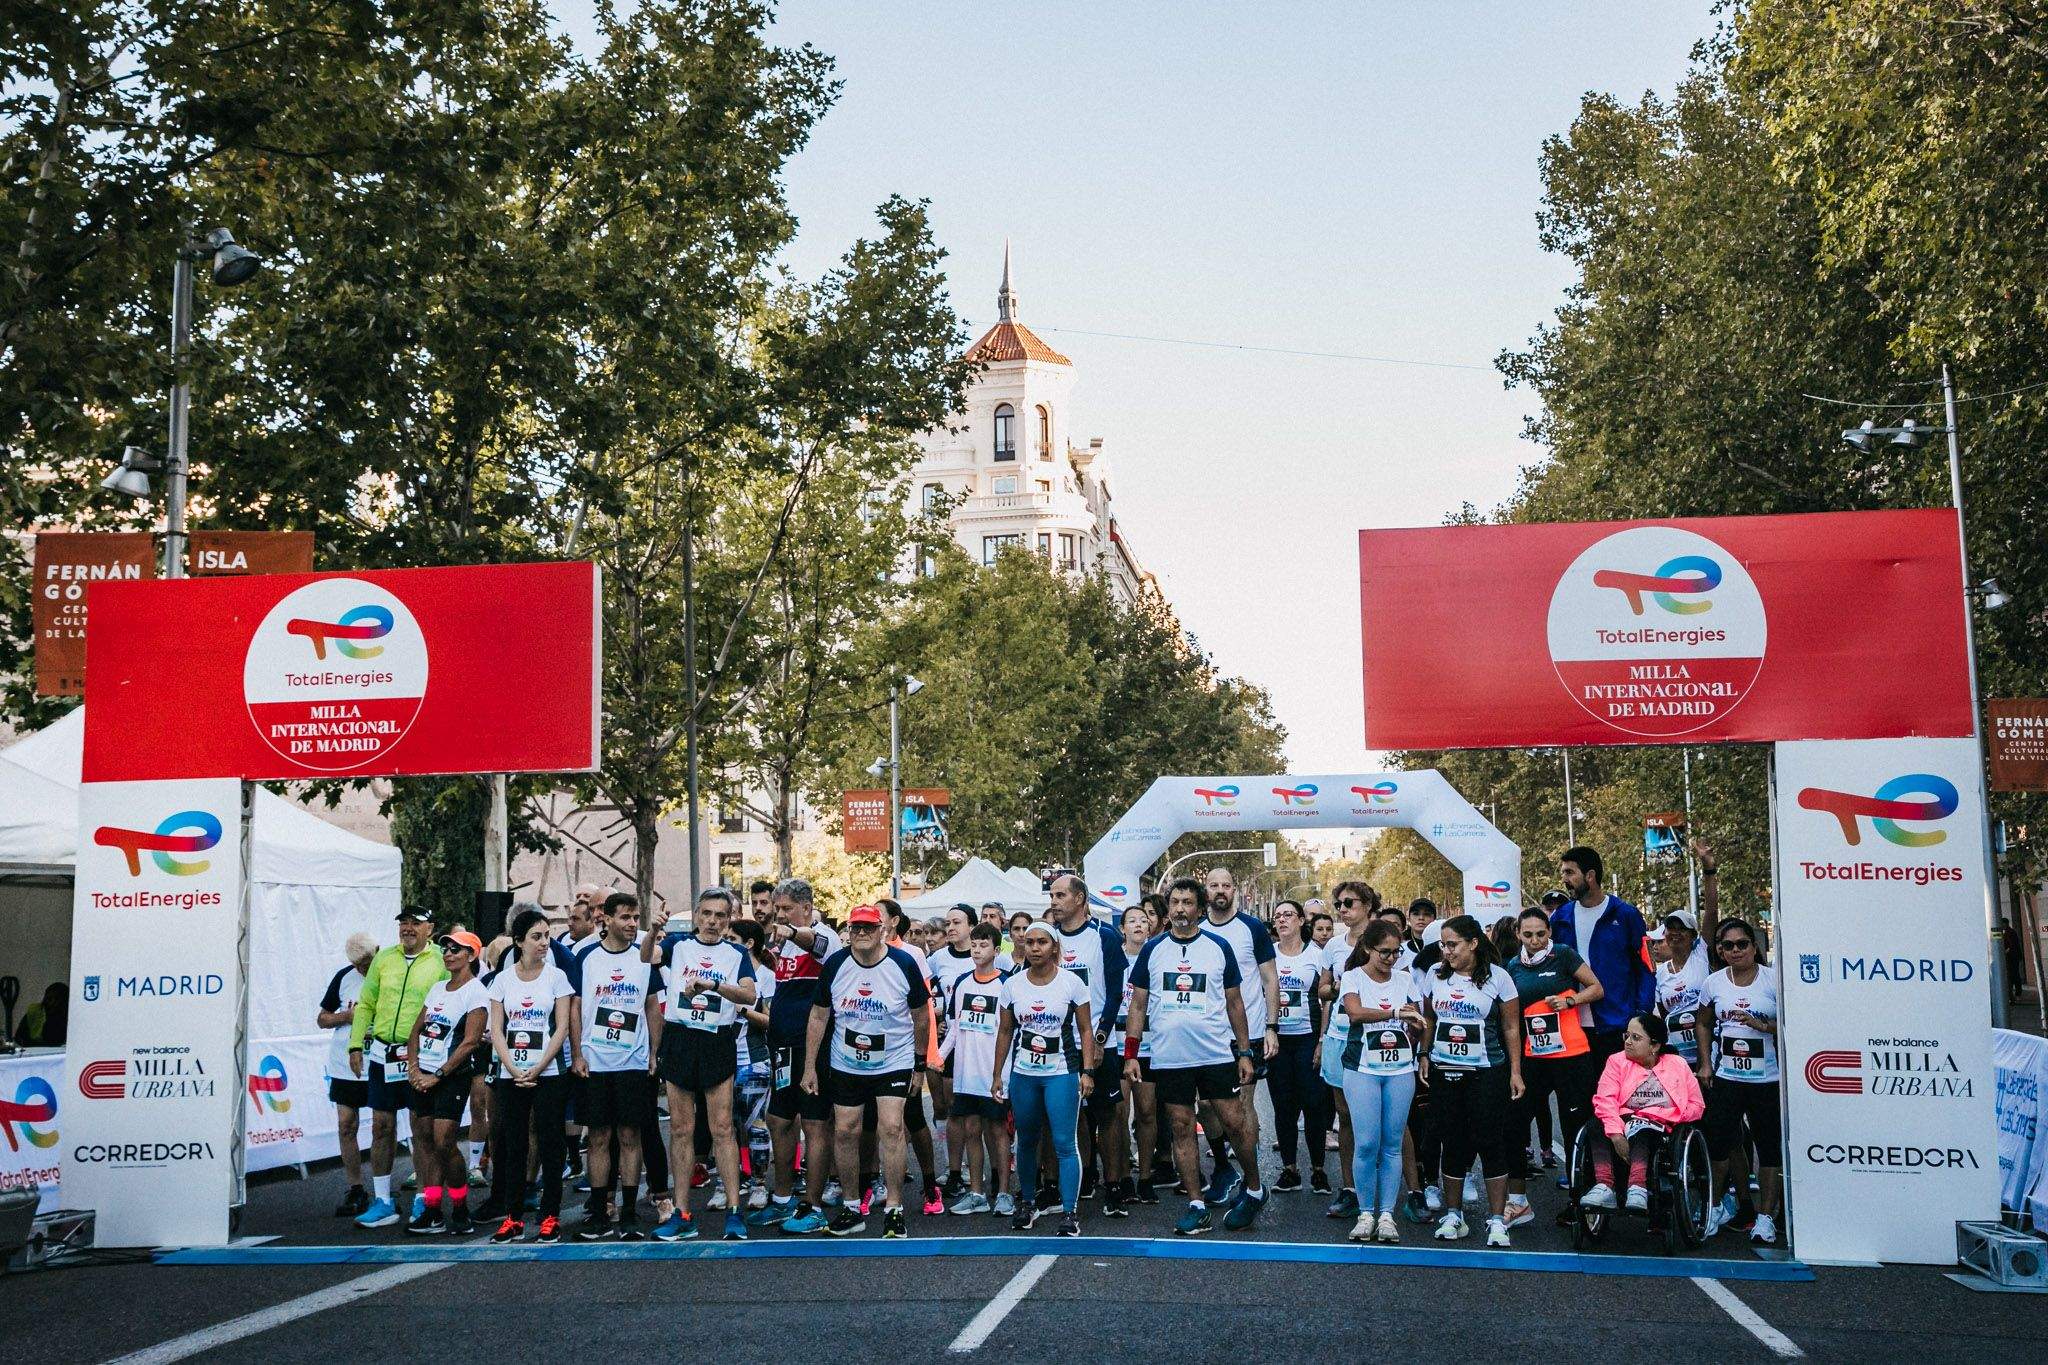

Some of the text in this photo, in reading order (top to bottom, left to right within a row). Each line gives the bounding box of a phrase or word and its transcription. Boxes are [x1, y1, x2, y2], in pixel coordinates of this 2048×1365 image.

[198, 550, 248, 569] ISLA
[46, 560, 141, 580] FERNÁN
[46, 630, 86, 638] DE LA
[1596, 626, 1726, 646] TotalEnergies
[1630, 664, 1691, 679] MILLA
[285, 670, 393, 687] TotalEnergies
[310, 704, 362, 719] MILLA
[1608, 701, 1715, 717] DE MADRID
[290, 738, 381, 753] DE MADRID
[848, 799, 885, 808] FERNÁN
[905, 795, 925, 803] ISLA
[848, 808, 885, 816] GÓMEZ
[1195, 810, 1241, 818] TotalEnergies
[1272, 809, 1320, 817] TotalEnergies
[1351, 807, 1399, 816] TotalEnergies
[1647, 818, 1665, 826] ISLA
[1799, 862, 1963, 886] TotalEnergies
[92, 889, 221, 910] TotalEnergies
[1842, 957, 1974, 983] MADRID
[118, 974, 223, 997] MADRID
[1177, 992, 1190, 1004] 44
[691, 1010, 705, 1021] 94
[968, 1012, 985, 1024] 311
[606, 1028, 620, 1041] 64
[423, 1039, 434, 1050] 58
[1867, 1037, 1939, 1048] new balance
[153, 1046, 190, 1055] balance
[514, 1050, 528, 1062] 93
[856, 1050, 870, 1062] 55
[1379, 1050, 1399, 1062] 128
[1448, 1043, 1468, 1056] 129
[1030, 1053, 1046, 1065] 121
[1732, 1057, 1752, 1070] 130
[1870, 1051, 1961, 1073] MILLA
[132, 1058, 206, 1077] MILLA
[132, 1080, 217, 1099] URBANA
[1871, 1076, 1975, 1098] URBANA
[247, 1127, 304, 1144] TotalEnergies
[0, 1162, 61, 1189] TotalEnerg
